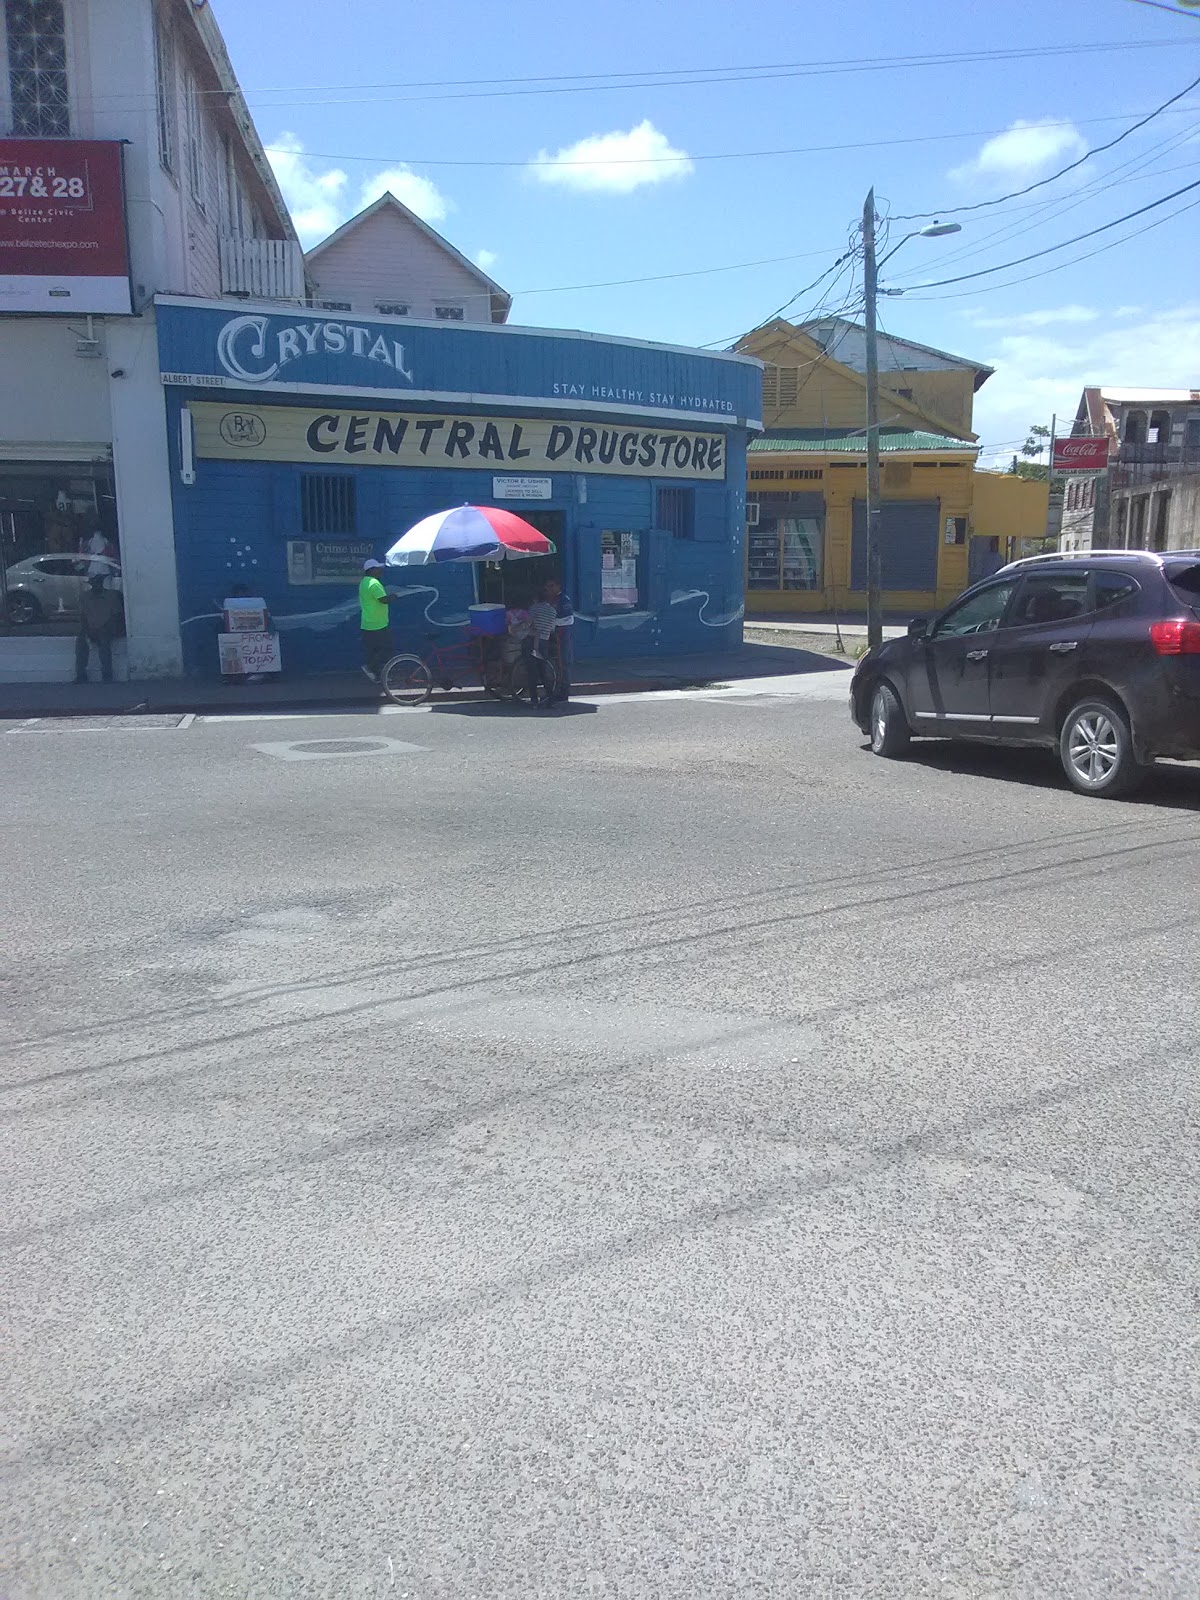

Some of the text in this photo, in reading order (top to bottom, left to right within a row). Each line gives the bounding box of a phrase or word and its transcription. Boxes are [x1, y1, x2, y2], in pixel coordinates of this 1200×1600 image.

[0, 166, 56, 176] MARCH
[10, 208, 43, 216] Belize
[216, 315, 413, 383] CRYSTAL
[162, 374, 225, 386] ALBERT STREET
[553, 383, 585, 394] STAY
[649, 392, 675, 404] STAY
[306, 414, 722, 472] CENTRAL DRUGSTORE
[315, 542, 374, 554] Crime info?
[241, 644, 273, 656] SALE
[242, 655, 277, 665] TODAY
